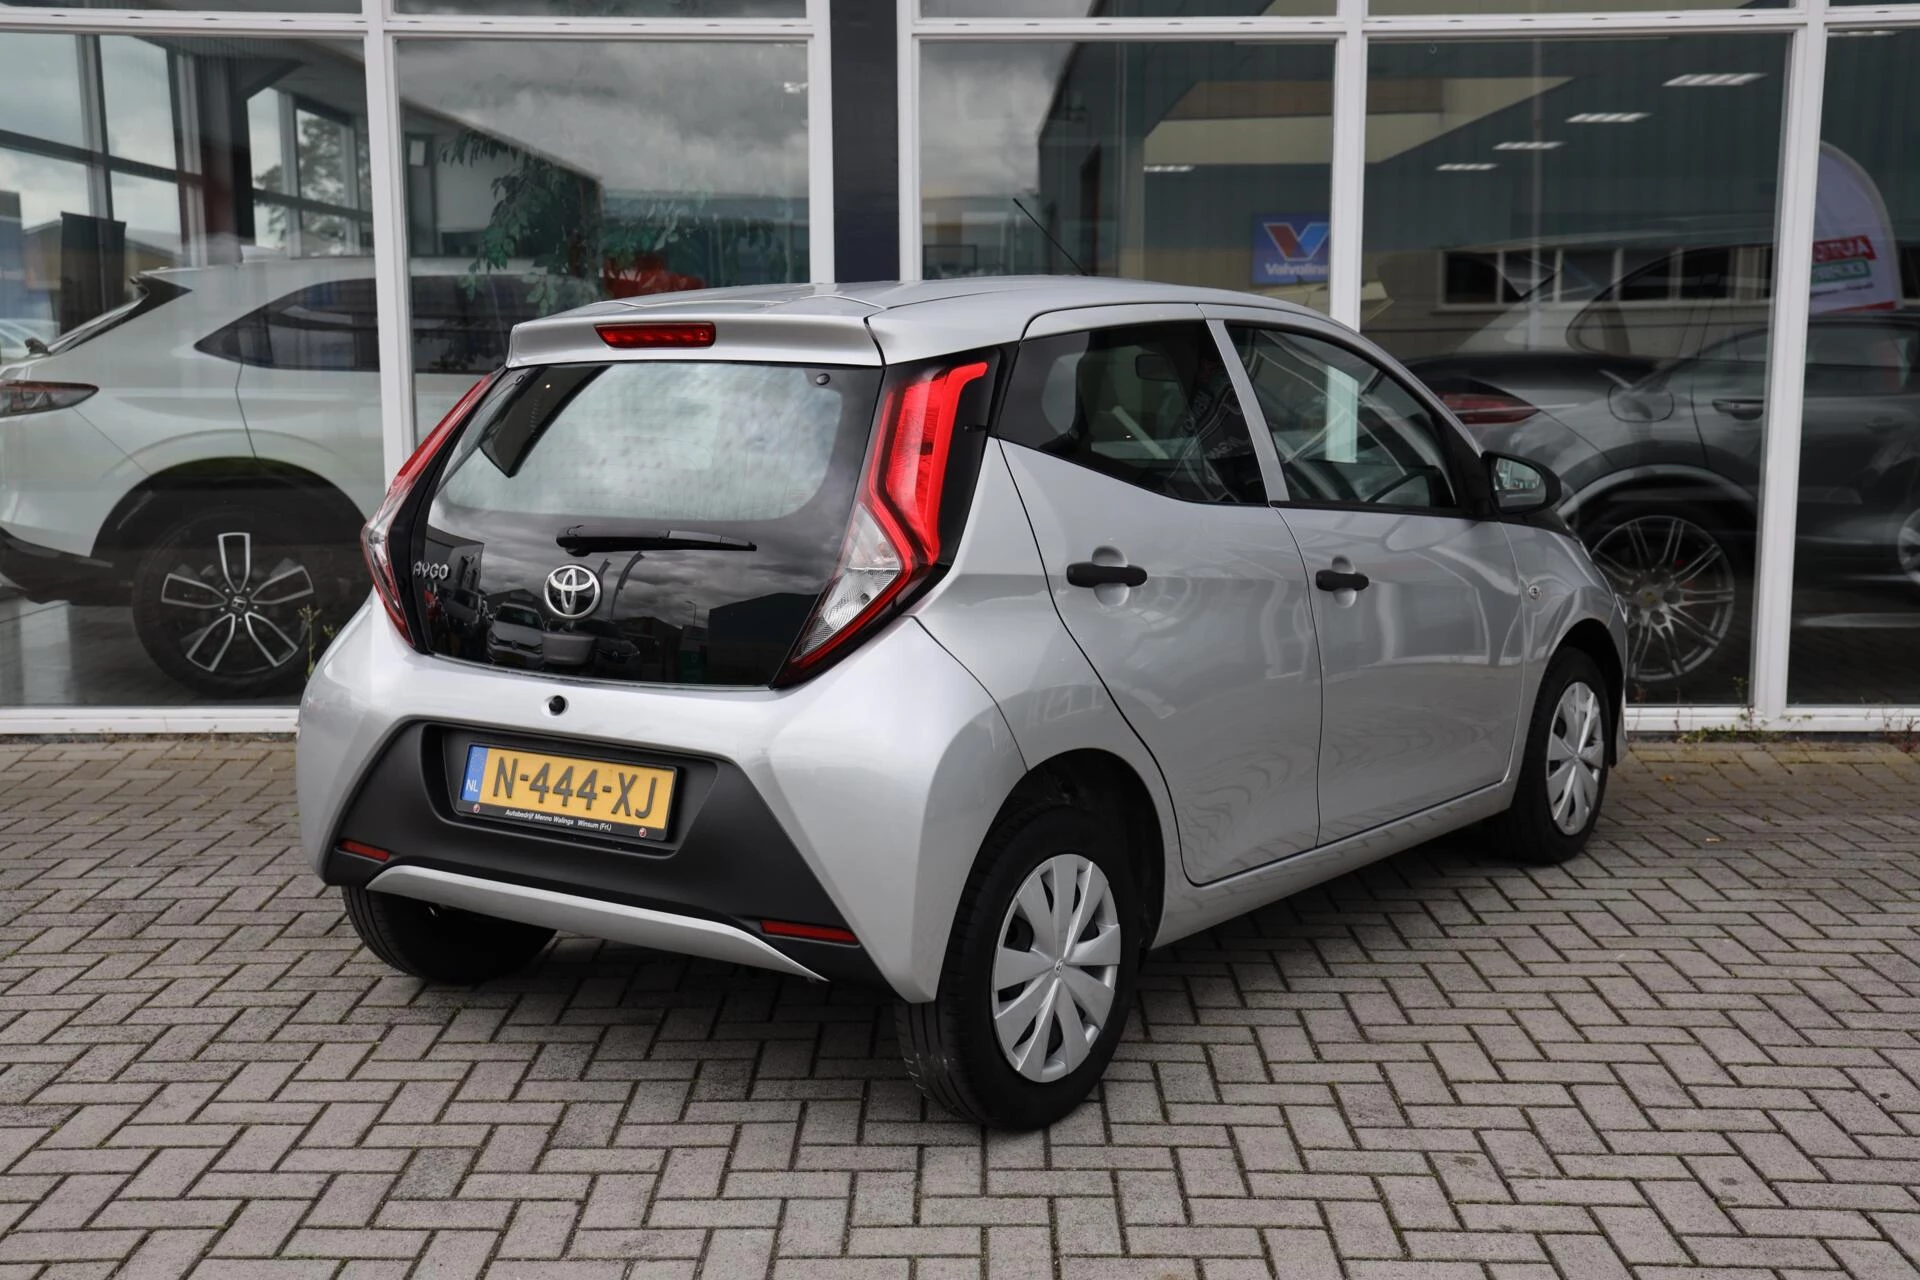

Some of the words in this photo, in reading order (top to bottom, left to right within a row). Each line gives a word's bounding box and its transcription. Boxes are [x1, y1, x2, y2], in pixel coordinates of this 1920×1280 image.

[412, 560, 449, 580] AYGO
[466, 778, 479, 793] NL
[493, 756, 657, 818] N-444-XJ
[505, 809, 534, 820] Autobedrijf
[534, 813, 552, 822] Menno
[578, 819, 598, 828] Winsum
